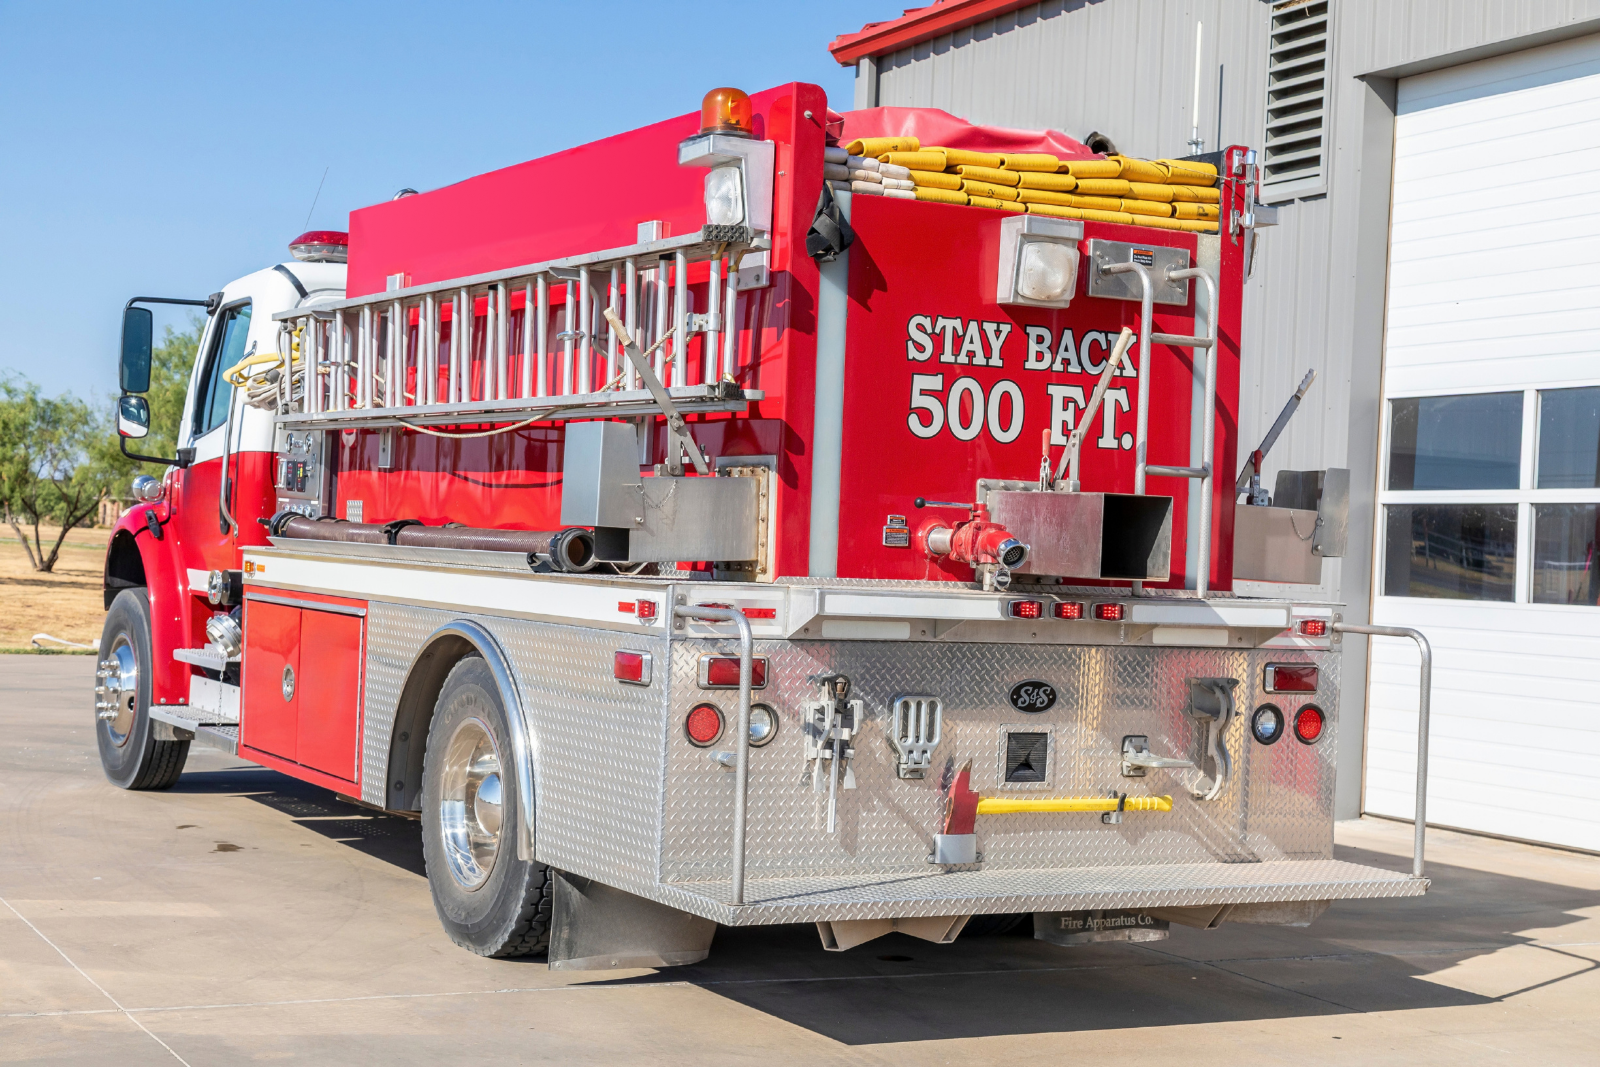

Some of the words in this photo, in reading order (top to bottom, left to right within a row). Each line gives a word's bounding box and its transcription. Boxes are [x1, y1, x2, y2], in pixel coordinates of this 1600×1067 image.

[905, 313, 1013, 368] STAY
[1023, 324, 1138, 378] BACK
[906, 372, 1025, 444] 500
[1046, 383, 1135, 451] FT.
[1016, 686, 1052, 708] S&S
[1060, 917, 1083, 929] Fire
[1085, 915, 1136, 931] Apparatus
[1138, 913, 1154, 926] Co.
